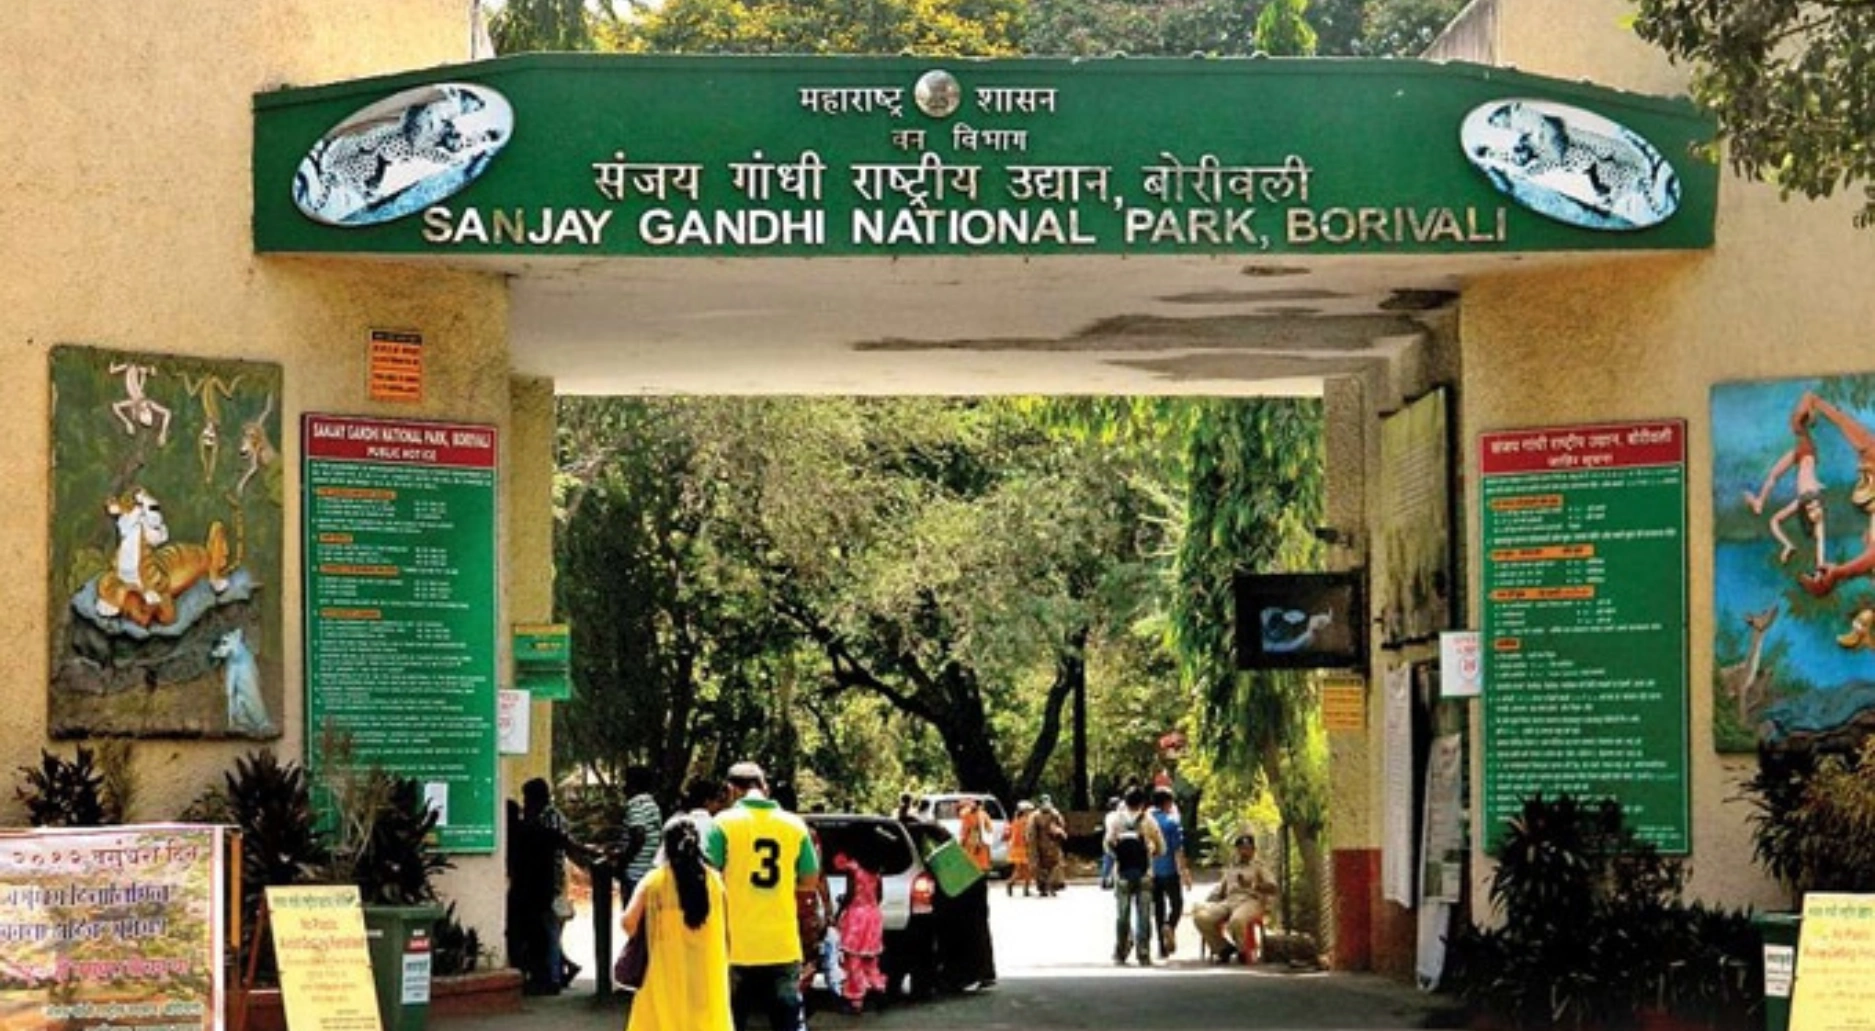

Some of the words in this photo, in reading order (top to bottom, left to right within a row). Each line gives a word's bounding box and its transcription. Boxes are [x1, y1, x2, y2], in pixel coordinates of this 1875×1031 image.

[800, 88, 903, 117] महाराष्ट्र
[976, 88, 1057, 112] शासन
[891, 130, 926, 150] वन
[953, 122, 1027, 151] विभाग
[592, 151, 703, 200] संजय
[728, 150, 828, 200] गांधी
[851, 152, 982, 208] राष्ट्रीय
[1005, 165, 1124, 210] उद्यान,
[1142, 152, 1312, 202] बोरीवली
[422, 206, 613, 245] SANJAY
[639, 208, 825, 245] GANDHI
[852, 208, 1097, 245] NATIONAL
[1125, 207, 1269, 249] PARK,
[1286, 207, 1506, 243] BORIVALI
[750, 838, 780, 888] 3
